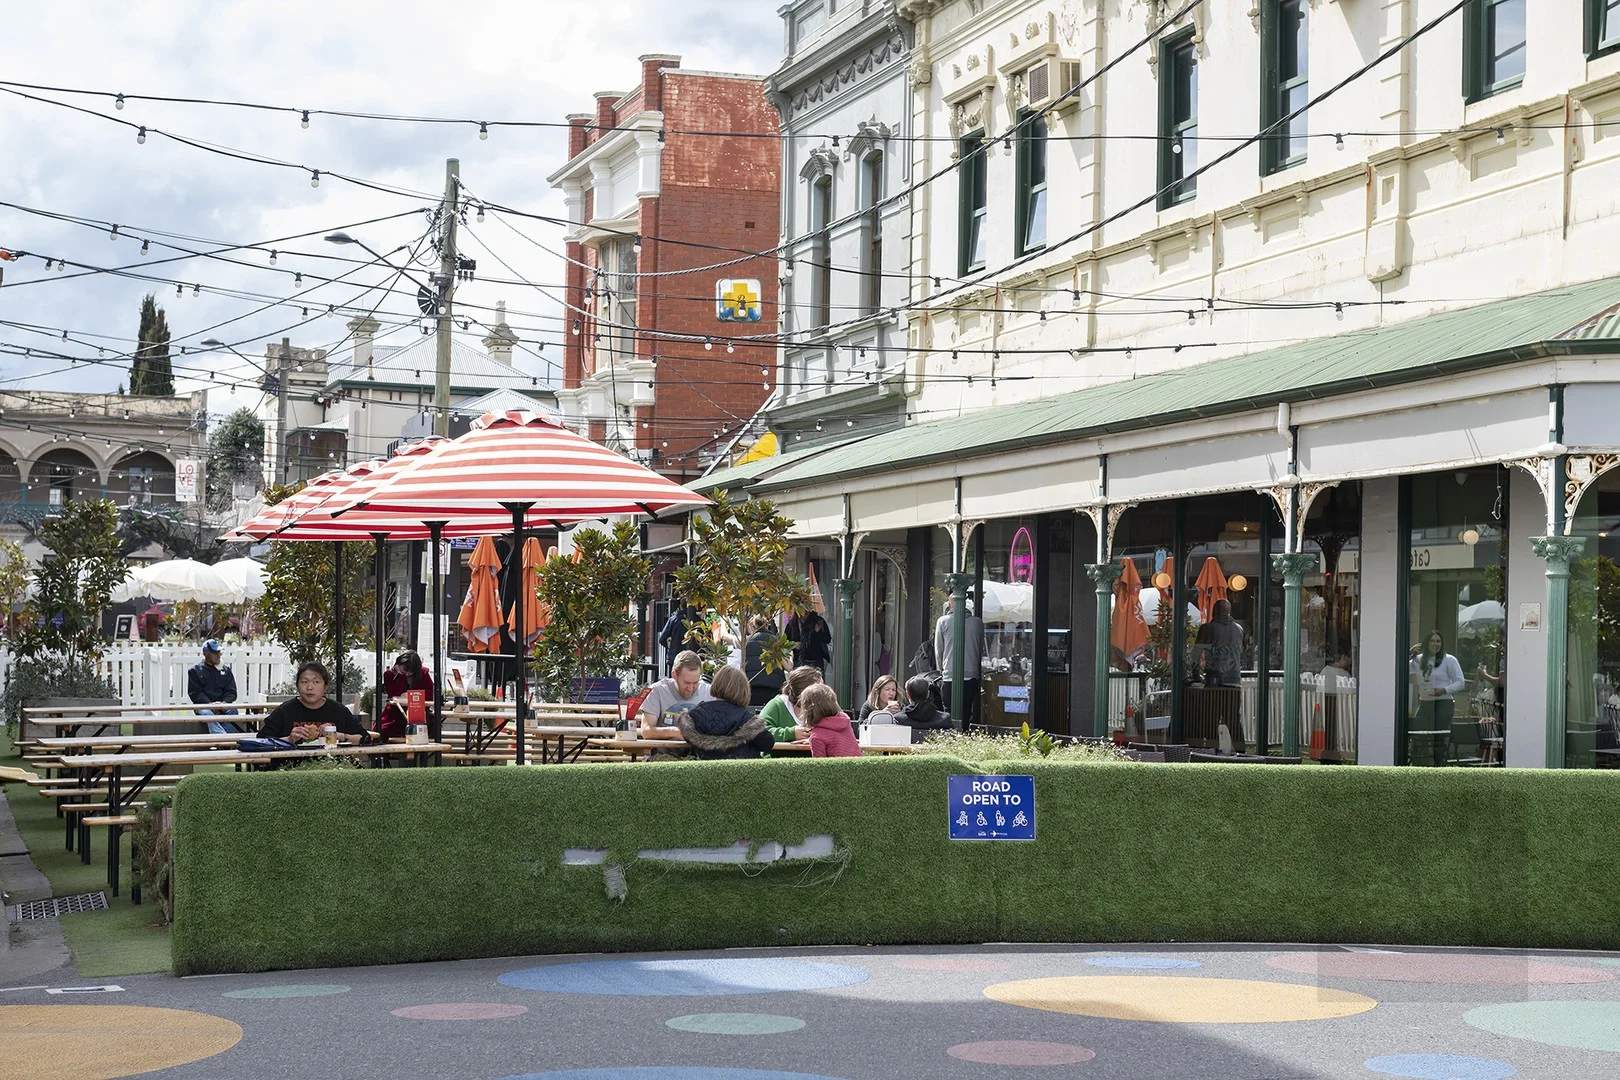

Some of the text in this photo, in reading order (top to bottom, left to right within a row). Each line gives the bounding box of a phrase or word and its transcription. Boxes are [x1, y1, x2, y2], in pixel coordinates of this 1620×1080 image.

[972, 781, 1011, 792] ROAD
[962, 794, 1021, 805] OPEN TO
